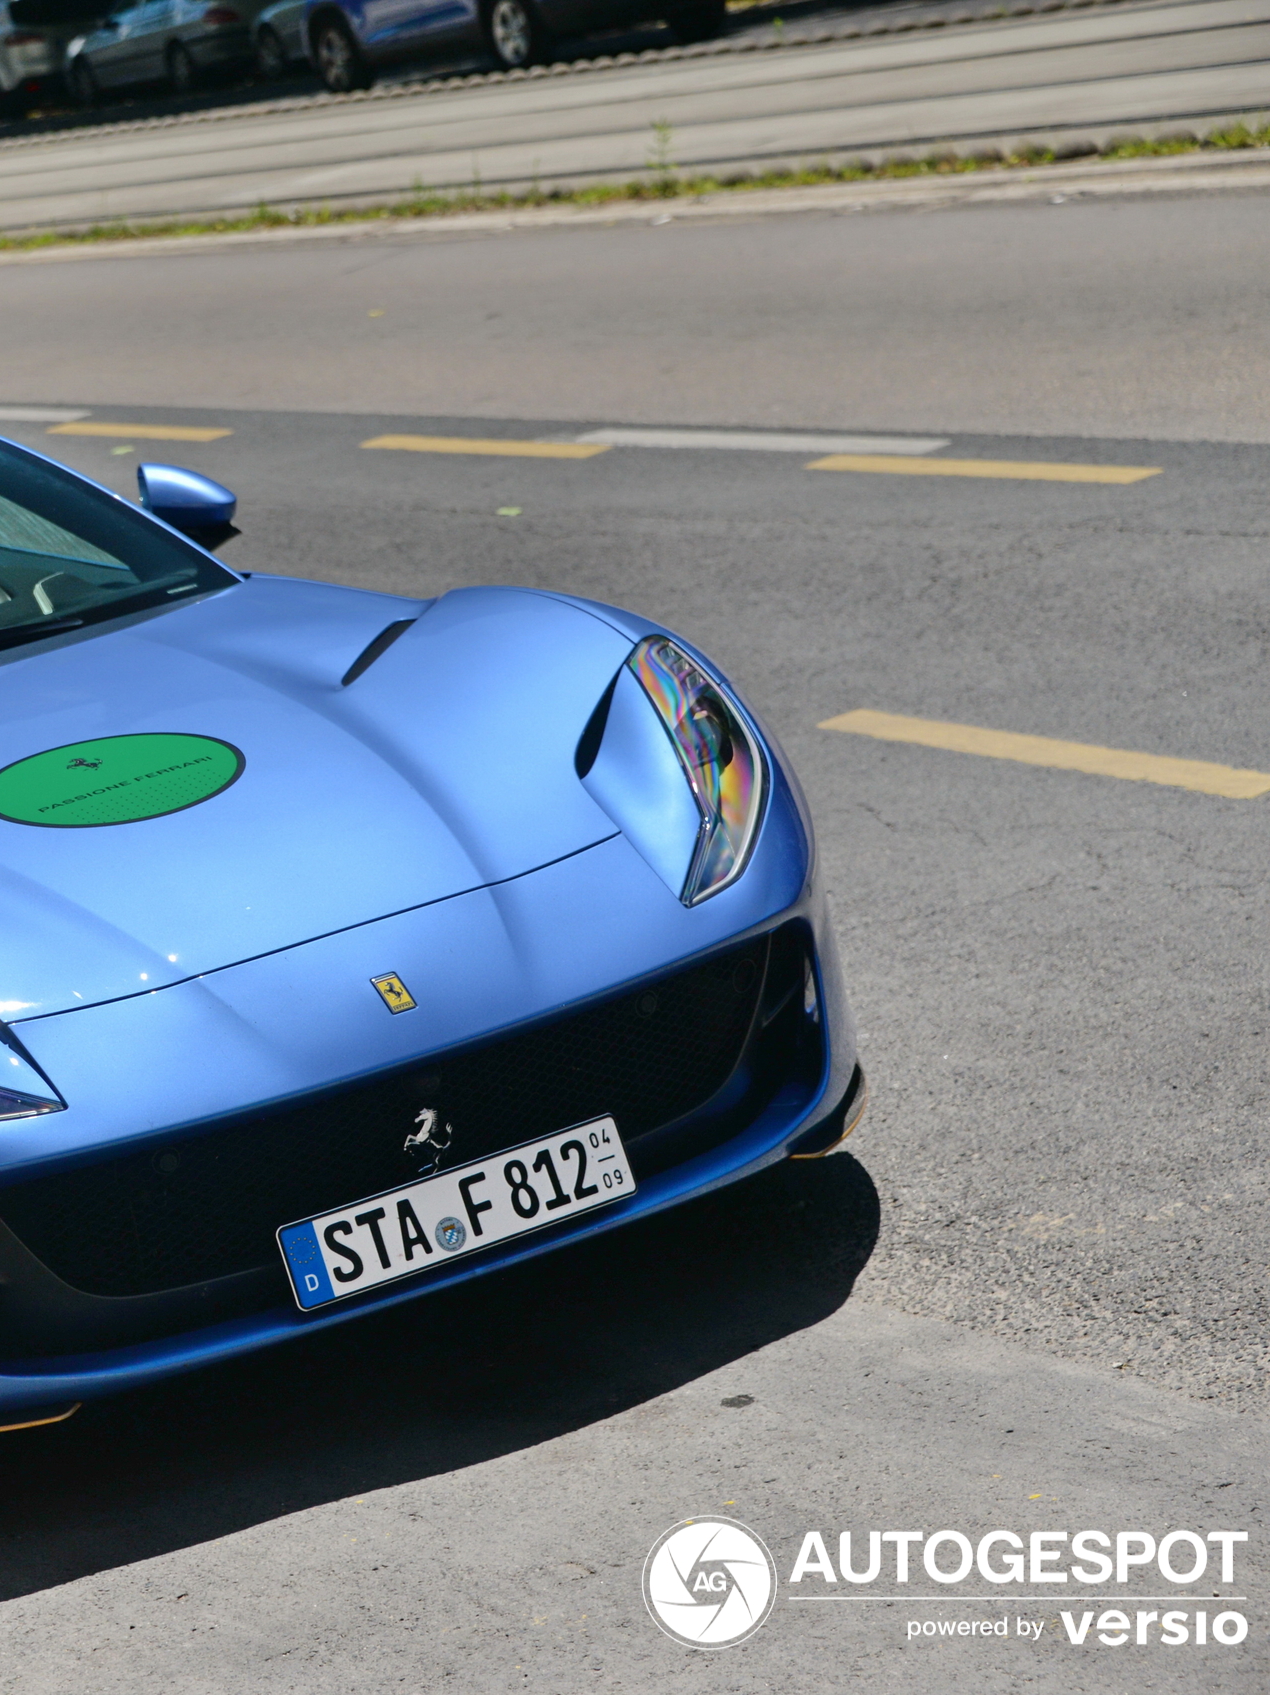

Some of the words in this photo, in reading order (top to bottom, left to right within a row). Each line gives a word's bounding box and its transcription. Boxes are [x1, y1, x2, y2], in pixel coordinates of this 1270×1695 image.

[37, 780, 132, 813] PASSIONE
[133, 756, 213, 783] FERRARI
[589, 1128, 611, 1149] 04
[602, 1169, 624, 1189] 09
[323, 1198, 433, 1284] STA
[458, 1171, 493, 1237] F
[503, 1139, 599, 1219] 812
[304, 1273, 320, 1292] D
